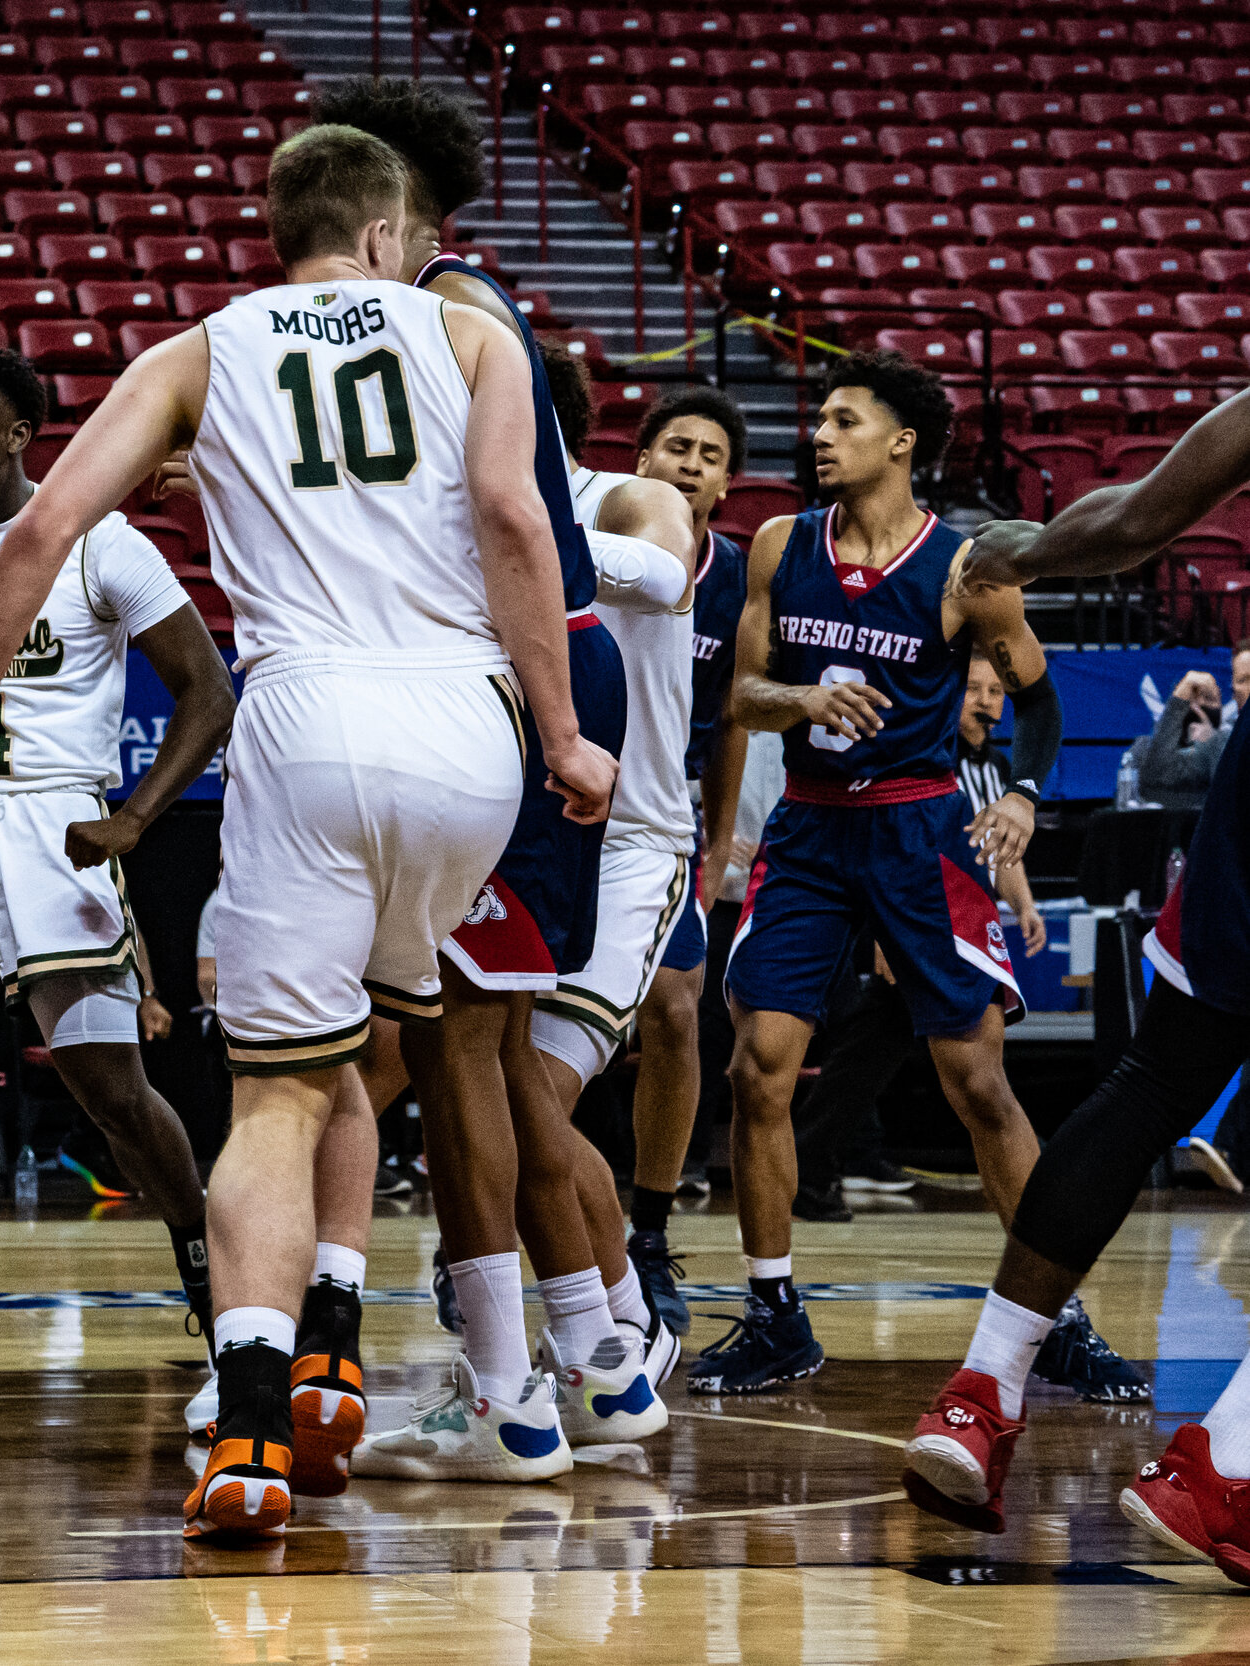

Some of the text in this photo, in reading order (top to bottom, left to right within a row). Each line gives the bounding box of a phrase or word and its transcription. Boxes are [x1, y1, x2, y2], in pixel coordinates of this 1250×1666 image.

[274, 344, 422, 492] 10
[779, 616, 924, 663] FRESNO STATE
[4, 660, 28, 677] NIV
[119, 717, 168, 744] AI
